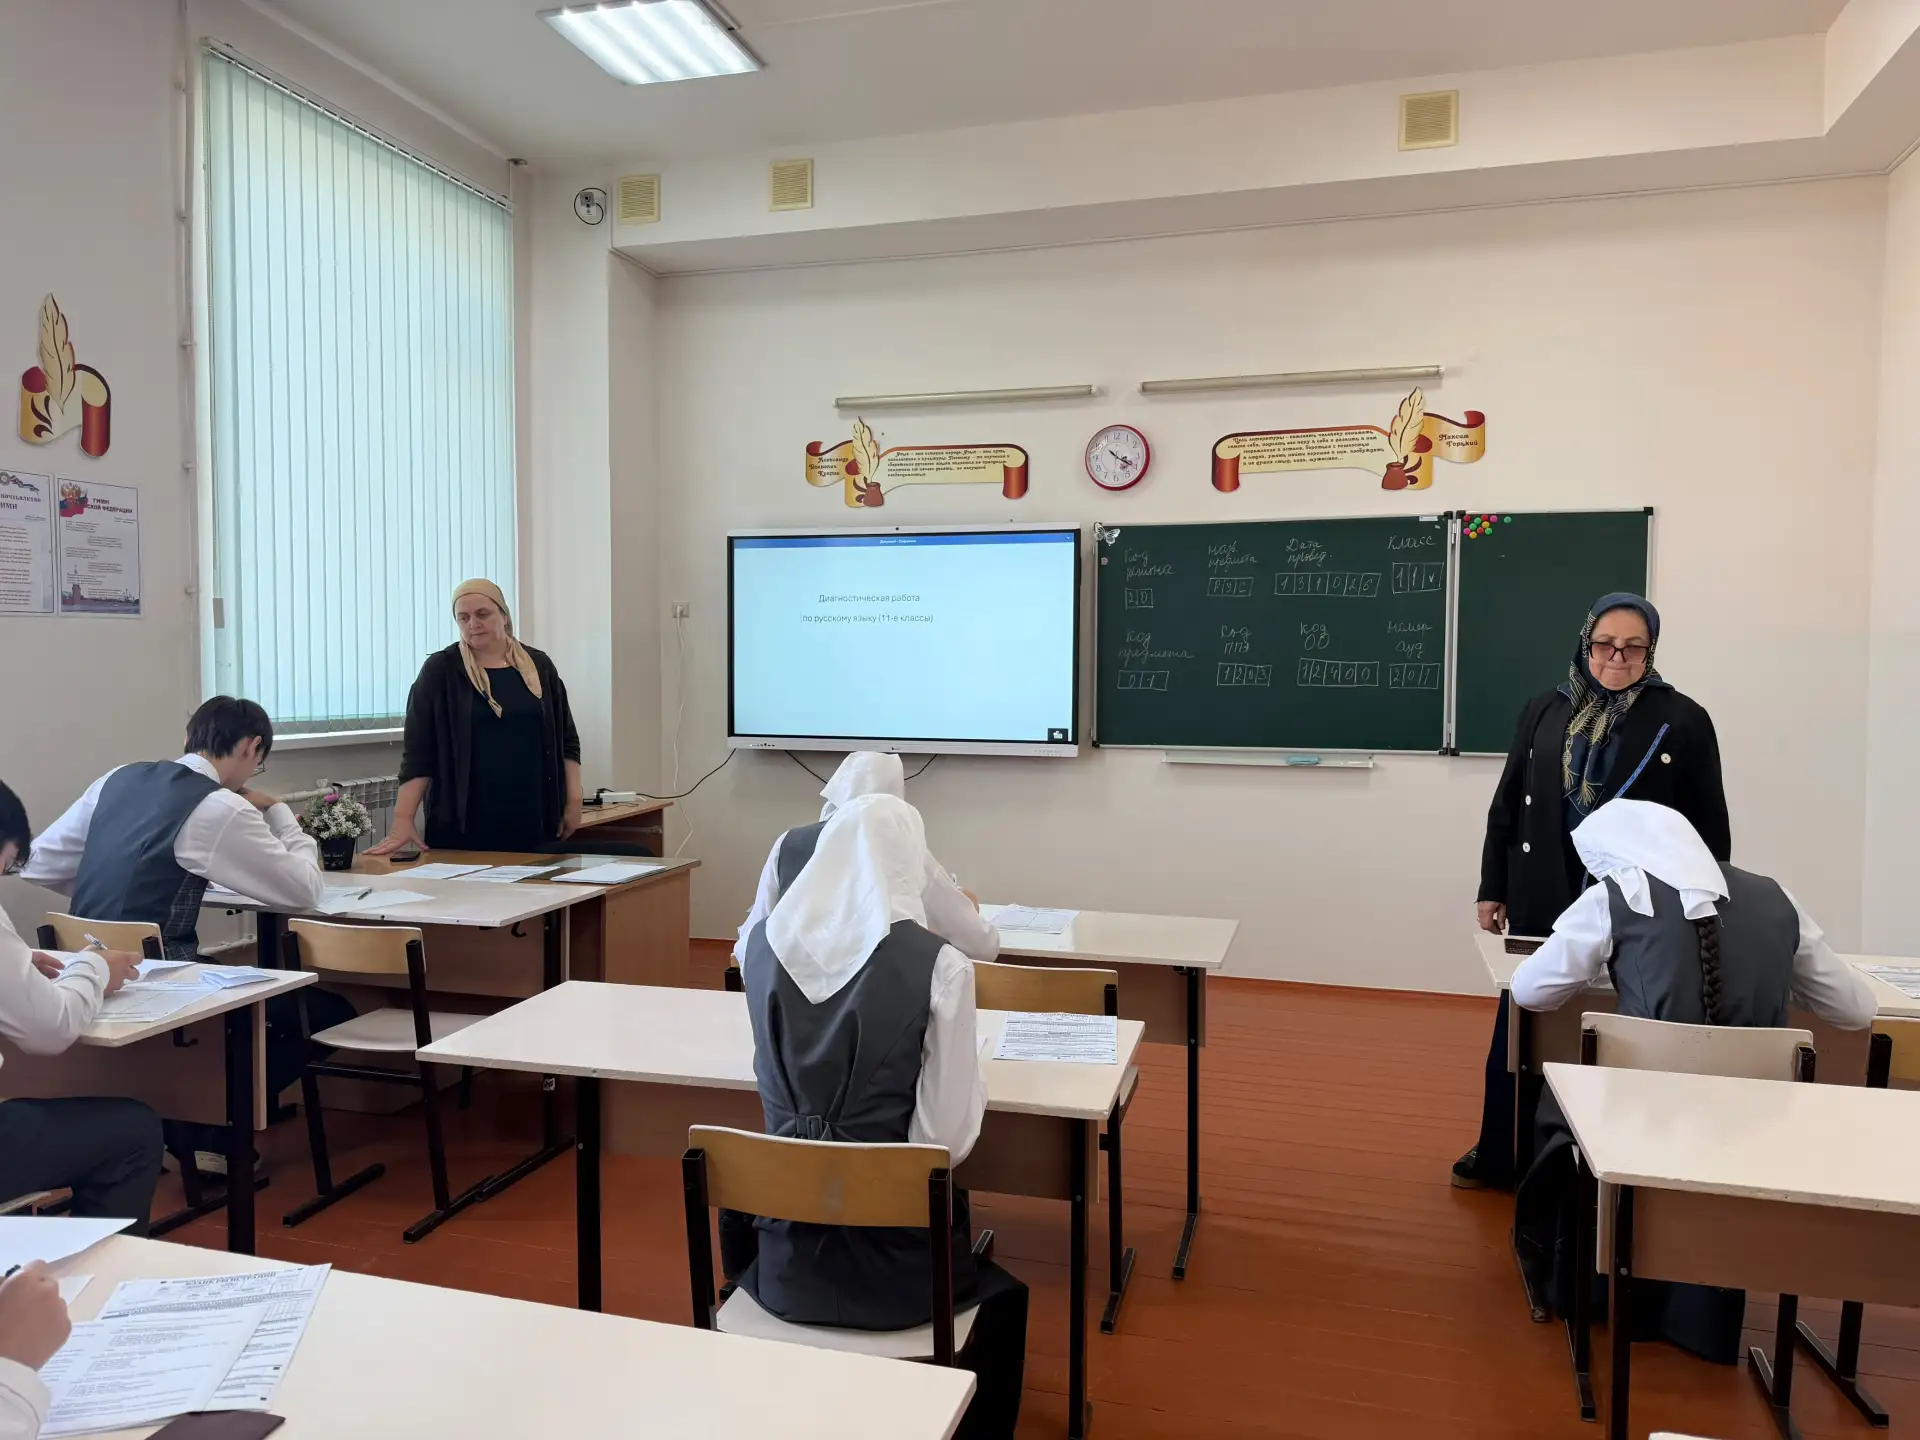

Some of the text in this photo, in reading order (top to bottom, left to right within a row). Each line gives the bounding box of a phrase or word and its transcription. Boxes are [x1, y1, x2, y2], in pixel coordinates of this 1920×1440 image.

[818, 594, 920, 603] Диагностическая работа
[802, 613, 934, 624] по русскому языку (11-е классы)
